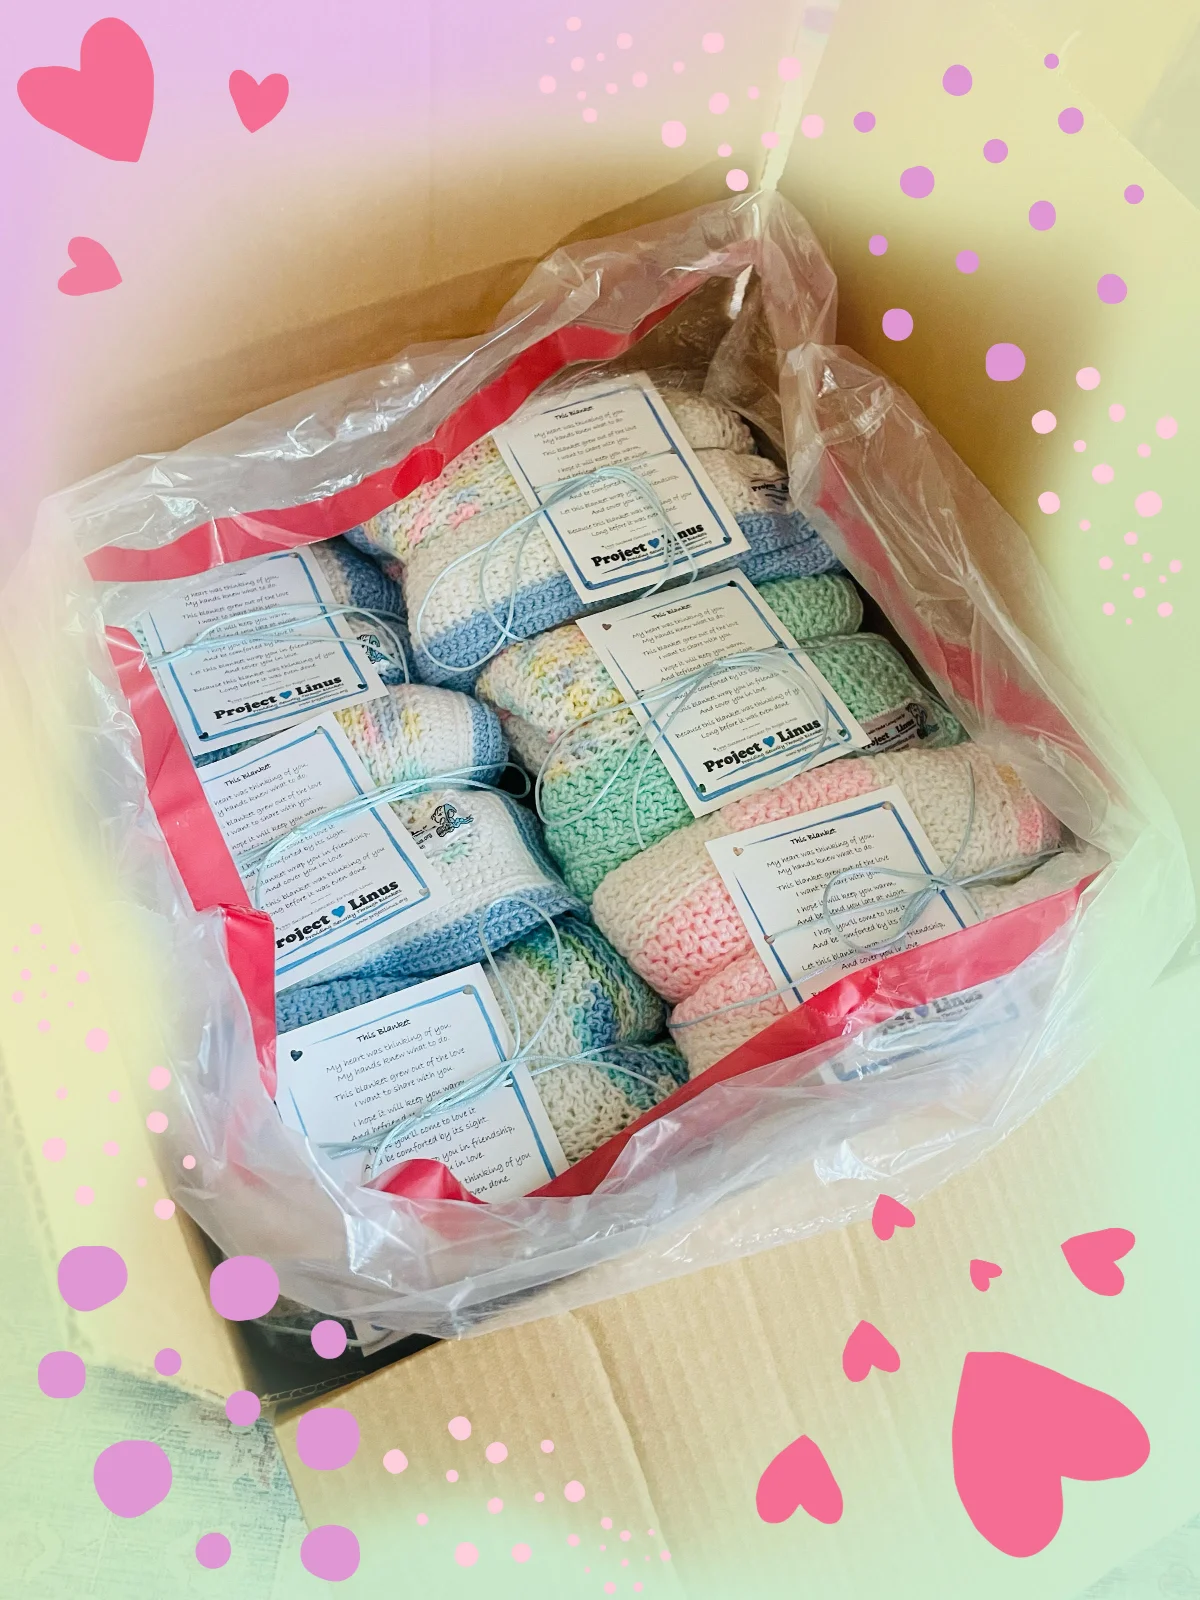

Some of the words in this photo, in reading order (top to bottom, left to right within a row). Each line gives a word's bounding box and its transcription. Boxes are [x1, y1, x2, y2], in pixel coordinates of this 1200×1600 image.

[590, 543, 648, 567] Project
[213, 695, 278, 720] Project
[294, 676, 342, 696] Linus
[702, 742, 763, 773] Project
[775, 719, 821, 743] Linus
[224, 777, 242, 787] This
[240, 763, 272, 780] Blanket
[789, 836, 808, 845] This
[806, 828, 836, 841] Blanket
[766, 860, 782, 868] My
[781, 854, 800, 863] heart
[800, 849, 816, 858] was
[814, 840, 850, 853] thinking
[849, 835, 858, 845] of
[777, 867, 793, 876] My
[791, 860, 816, 871] hands
[815, 855, 836, 864] knew
[835, 849, 855, 858] what
[265, 898, 282, 908] this
[281, 883, 311, 900] blanket
[326, 858, 362, 877] thinking
[362, 851, 371, 861] of
[371, 847, 386, 858] you
[283, 873, 301, 885] cover
[302, 866, 318, 878] you
[776, 882, 795, 891] This
[794, 873, 824, 886] blanket
[824, 868, 841, 879] grew
[855, 860, 863, 869] of
[874, 854, 890, 863] love
[799, 885, 820, 896] want
[848, 872, 866, 882] with
[800, 902, 818, 913] hope
[827, 894, 841, 904] will
[840, 891, 858, 900] keep
[858, 887, 874, 898] you
[276, 915, 331, 949] roject
[347, 881, 399, 911] Linus
[796, 915, 814, 927] And
[858, 913, 877, 923] come
[884, 906, 900, 915] love
[801, 962, 815, 971] Let
[815, 956, 832, 967] this
[356, 1031, 377, 1043] This
[376, 1018, 411, 1036] Blanket
[325, 1063, 343, 1074] My
[342, 1054, 366, 1067] heart
[365, 1047, 384, 1058] was
[383, 1033, 423, 1051] thinking
[423, 1026, 433, 1037] of
[337, 1072, 354, 1082] My
[354, 1060, 382, 1076] hands
[383, 1053, 405, 1064] knew
[406, 1043, 426, 1055] what
[334, 1090, 354, 1102] This
[354, 1077, 389, 1094] blanket
[389, 1068, 410, 1083] grew
[411, 1063, 425, 1073] out
[426, 1056, 435, 1067] of
[435, 1053, 449, 1063] the
[448, 1047, 465, 1058] love
[358, 1092, 381, 1106] want
[393, 1079, 416, 1093] share
[416, 1071, 436, 1083] with
[357, 1113, 377, 1126] hope
[377, 1109, 387, 1118] it
[386, 1102, 405, 1114] will
[405, 1096, 424, 1107] keep
[425, 1089, 442, 1103] you
[420, 1121, 442, 1135] come
[441, 1117, 451, 1126] to
[450, 1110, 468, 1122] love
[468, 1107, 476, 1115] it
[384, 1154, 395, 1163] be
[396, 1135, 438, 1158] comforted
[439, 1131, 452, 1142] by
[452, 1126, 464, 1135] its
[441, 1148, 459, 1163] you
[458, 1144, 471, 1152] in
[454, 1159, 466, 1168] in
[464, 1163, 504, 1184] thinking
[505, 1156, 514, 1168] of
[515, 1152, 532, 1167] you
